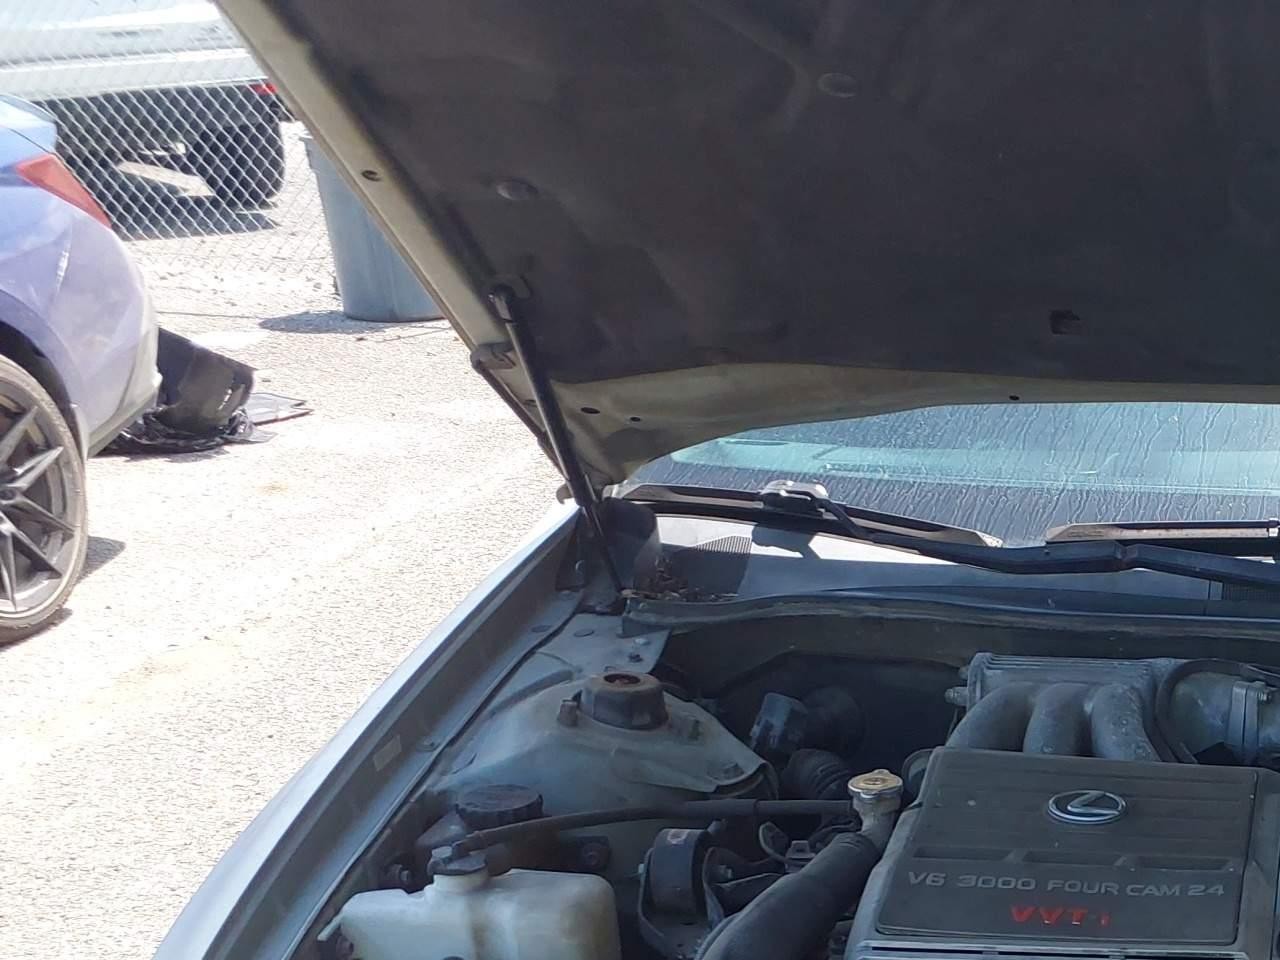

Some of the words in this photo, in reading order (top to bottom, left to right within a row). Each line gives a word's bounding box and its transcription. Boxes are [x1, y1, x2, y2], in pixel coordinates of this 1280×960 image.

[908, 871, 945, 886] V6
[956, 875, 1036, 890] 3000
[1047, 879, 1119, 895] FOUR
[1126, 885, 1181, 896] CAM
[1187, 885, 1225, 897] 24
